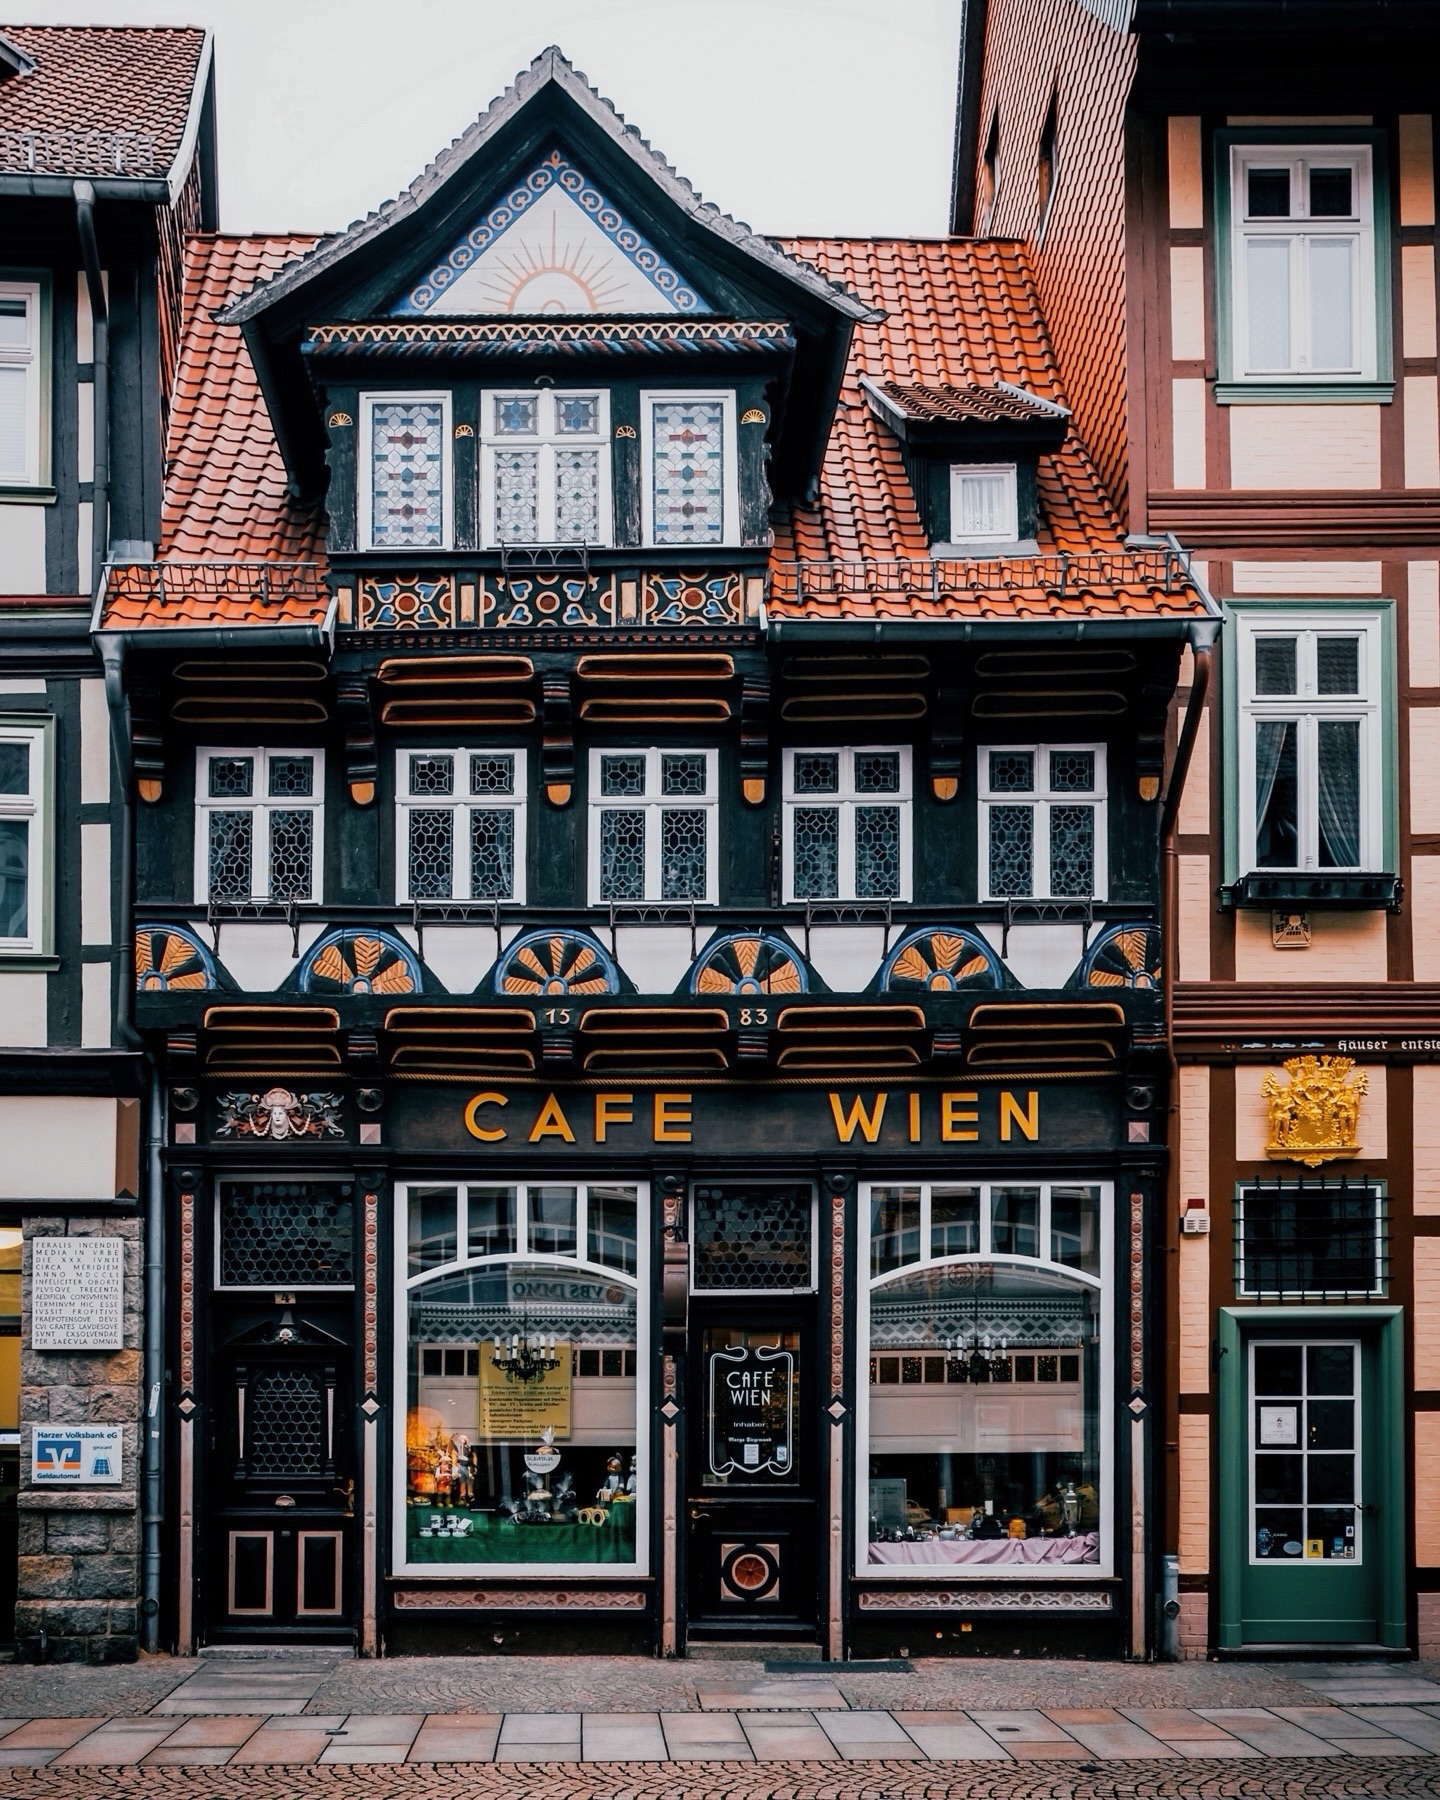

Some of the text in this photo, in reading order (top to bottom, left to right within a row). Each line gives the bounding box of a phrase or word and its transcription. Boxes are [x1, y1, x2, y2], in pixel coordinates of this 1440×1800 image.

[545, 1008, 768, 1026] 15 83
[1338, 1040, 1388, 1052] Häuser
[464, 1092, 1039, 1143] CAFE WIEN
[281, 1293, 291, 1302] 4
[731, 1390, 771, 1406] WIEN
